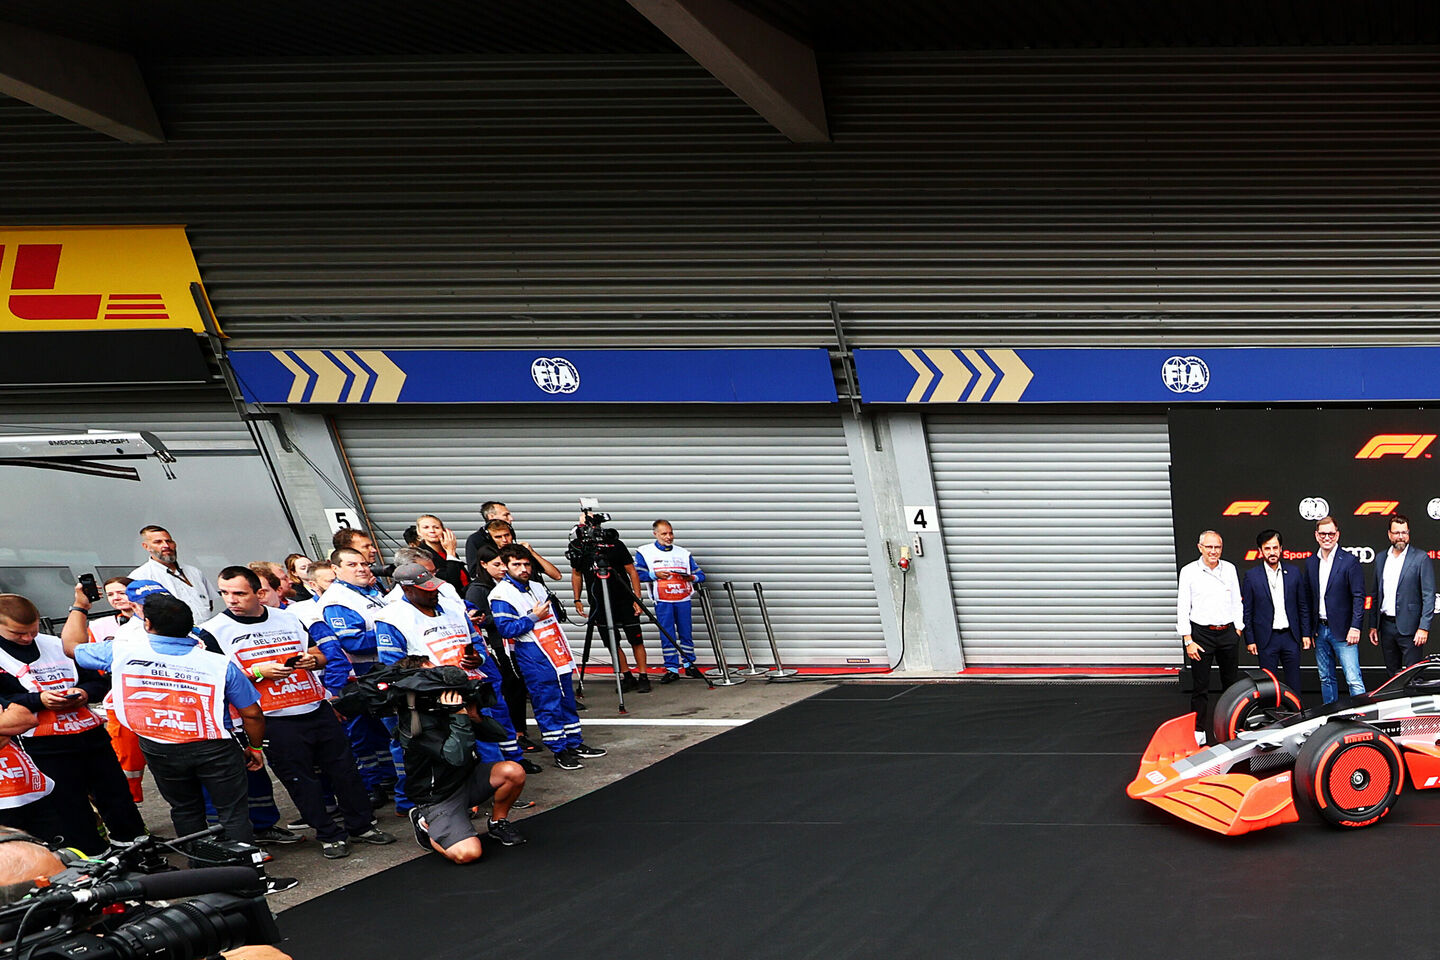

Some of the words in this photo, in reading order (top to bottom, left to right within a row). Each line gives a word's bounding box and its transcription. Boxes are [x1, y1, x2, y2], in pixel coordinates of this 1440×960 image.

[335, 512, 351, 529] 5
[913, 509, 928, 529] 4
[1283, 550, 1313, 561] Sport
[151, 669, 170, 677] BEL
[268, 680, 312, 696] LANE
[57, 711, 79, 722] PIT
[152, 708, 185, 721] PIT
[53, 717, 96, 732] LANE
[145, 716, 198, 732] LANE
[1344, 732, 1374, 744] PIRELLI
